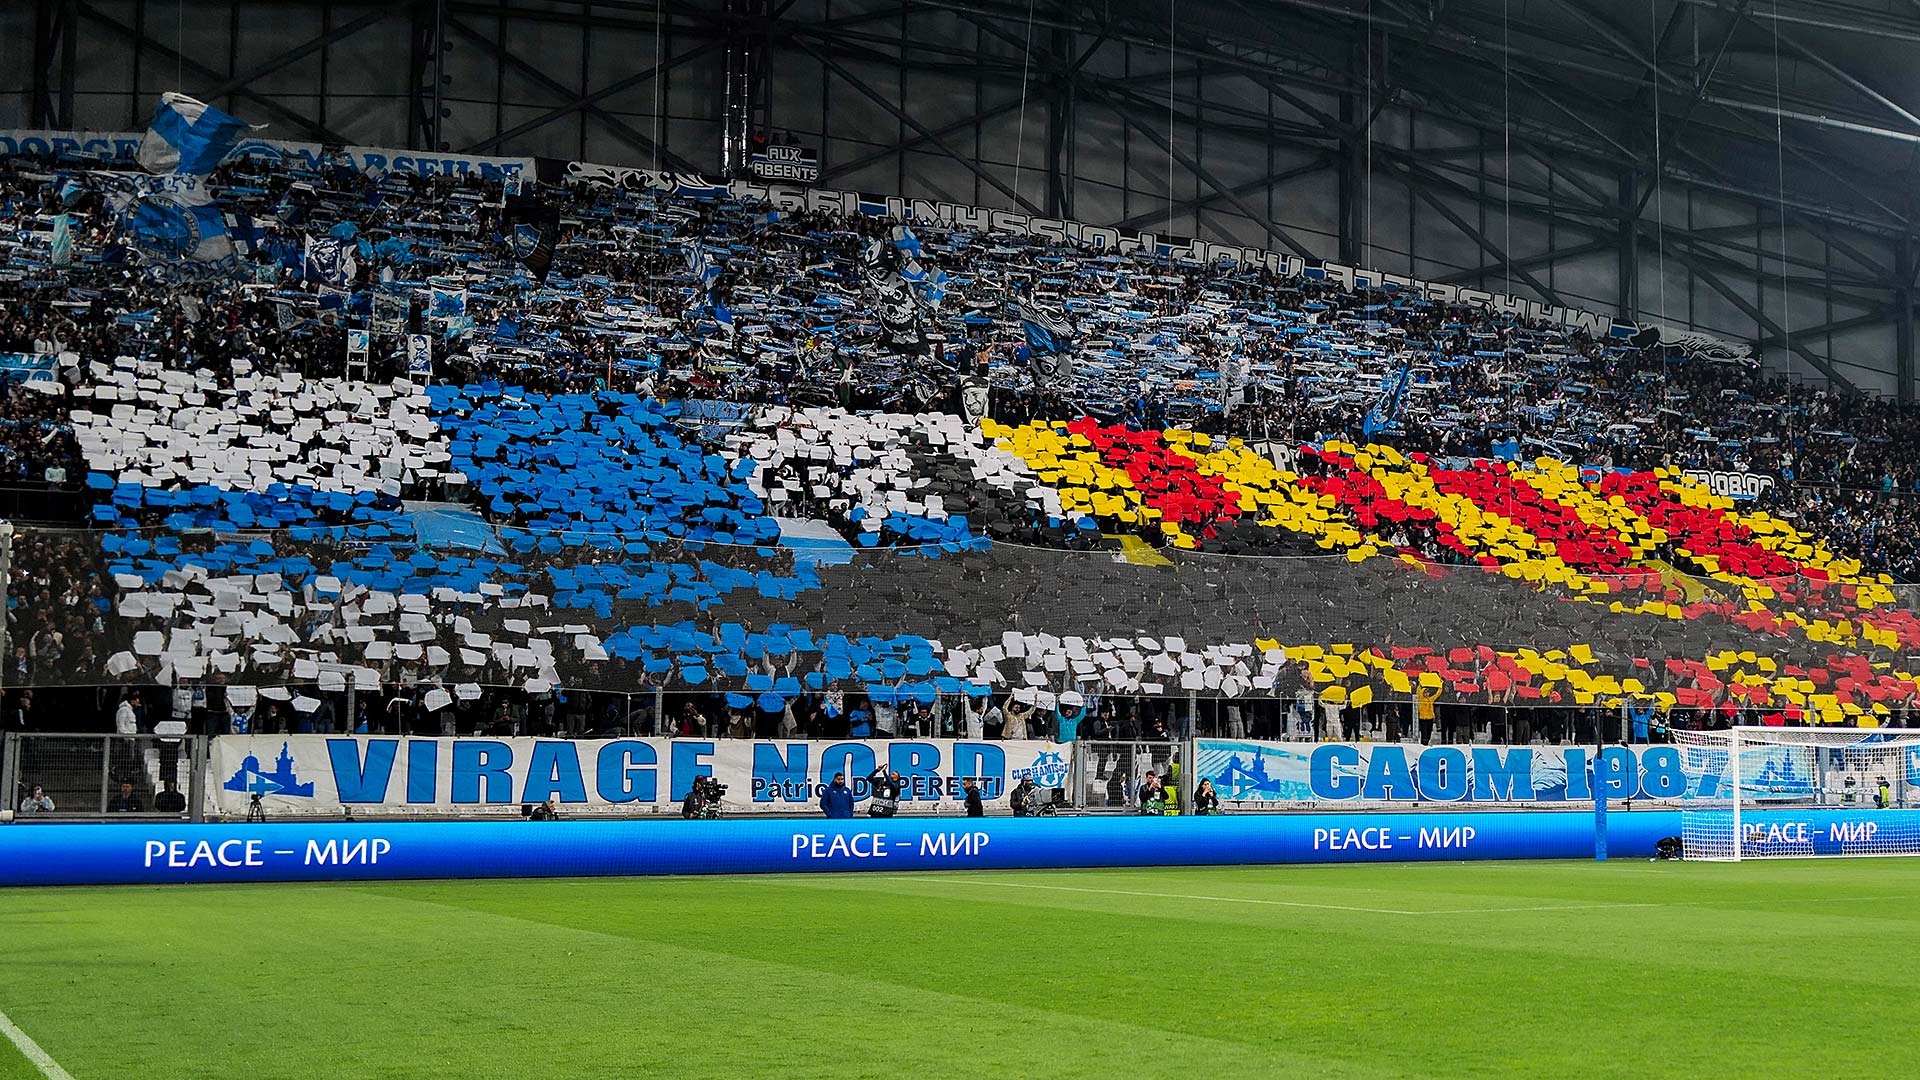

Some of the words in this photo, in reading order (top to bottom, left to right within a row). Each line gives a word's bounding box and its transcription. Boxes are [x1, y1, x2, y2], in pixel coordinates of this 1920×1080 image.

[298, 149, 524, 186] MRSEILLE
[769, 148, 798, 161] AUX
[754, 163, 817, 180] ABSENTS
[326, 738, 714, 803] VIRAGE
[752, 742, 1006, 802] NORD
[1310, 744, 1535, 800] CAOM
[1563, 745, 1728, 800] 1987
[751, 778, 829, 798] Patric
[792, 833, 888, 858] PEACE
[920, 832, 989, 856] МИР
[1314, 827, 1392, 850] PEACE
[1418, 826, 1476, 848] МИР
[144, 840, 263, 867] PEACE
[304, 838, 391, 865] МИР
